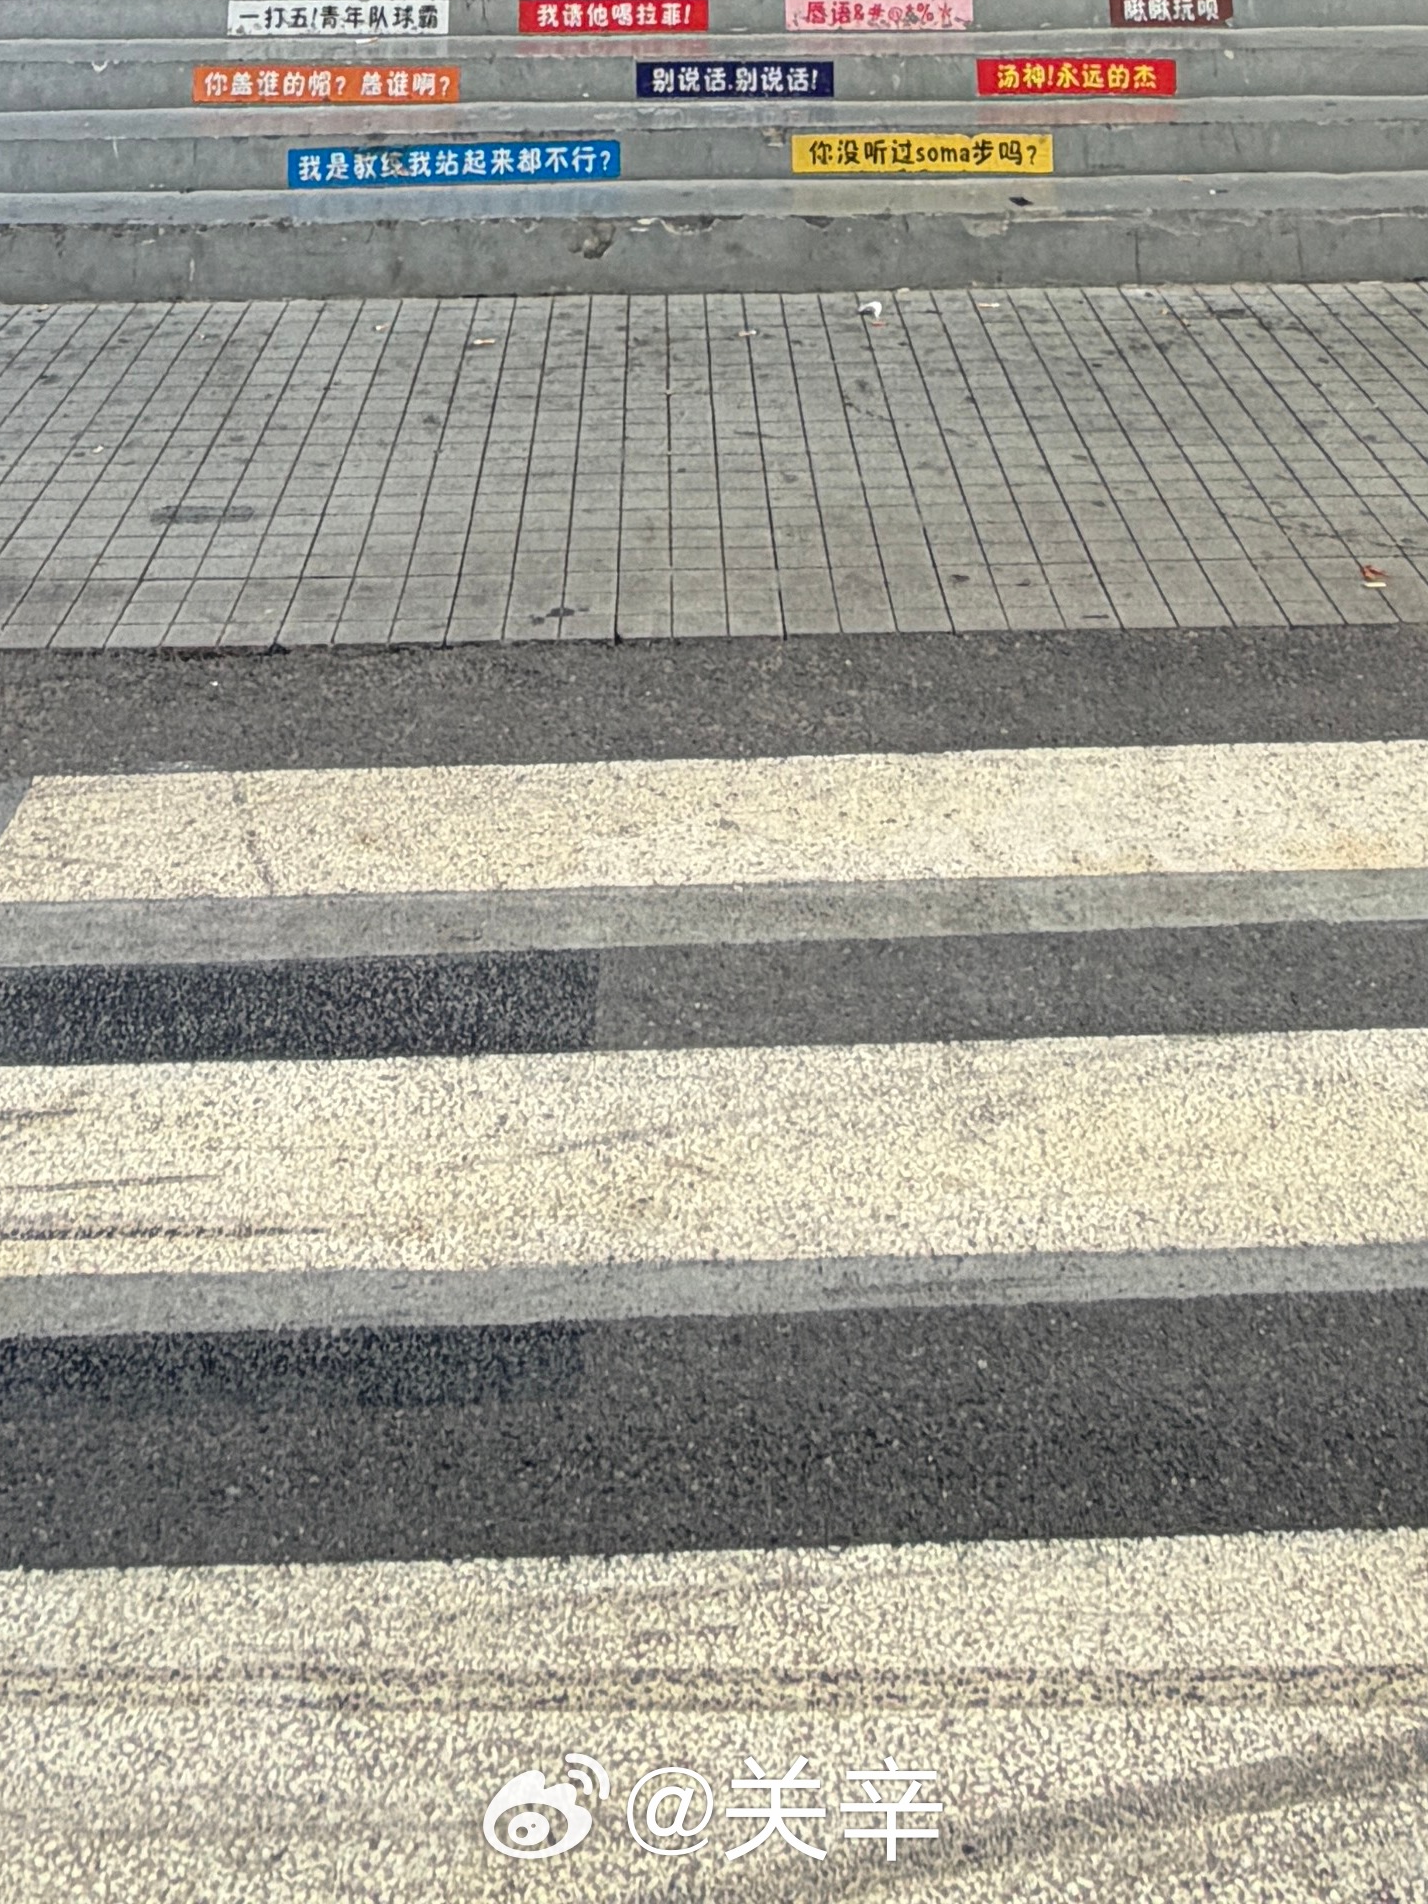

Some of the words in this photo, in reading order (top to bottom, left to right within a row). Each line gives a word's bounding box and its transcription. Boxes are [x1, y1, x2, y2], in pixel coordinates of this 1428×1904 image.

[239, 5, 439, 30] 一打五!青年队球霸
[537, 2, 692, 28] 我请他喝拉菲!
[997, 62, 1158, 90] 汤神!永远的杰
[298, 146, 612, 183] 我是教练我站起来都不行?
[808, 139, 1039, 166] 你没听过soma步吗?
